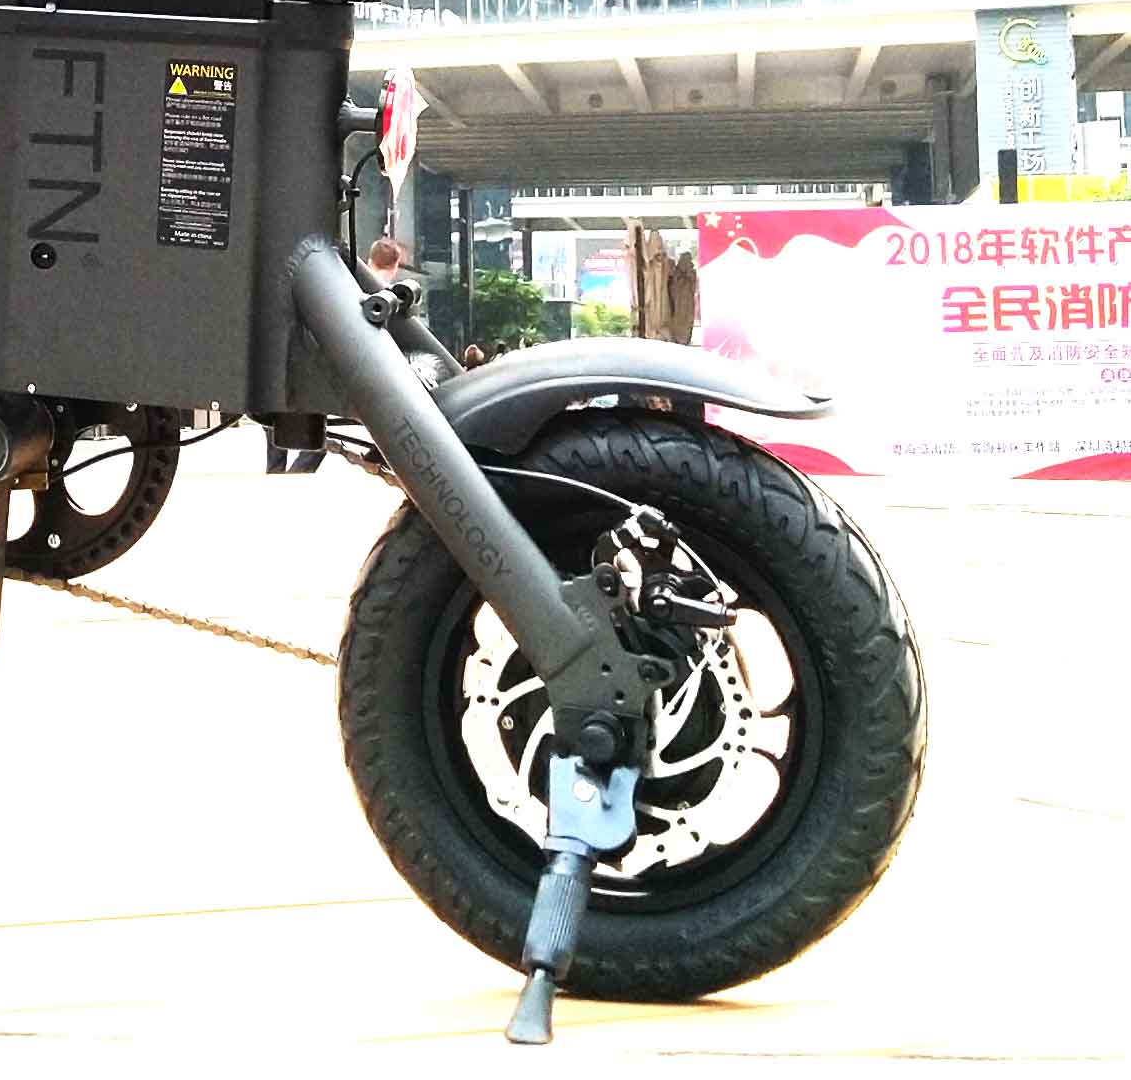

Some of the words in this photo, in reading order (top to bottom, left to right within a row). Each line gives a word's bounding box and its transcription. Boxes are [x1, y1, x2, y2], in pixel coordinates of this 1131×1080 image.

[170, 63, 234, 80] WARNING
[27, 48, 105, 243] FTN
[885, 225, 1131, 266] 2018年软件产
[942, 282, 1131, 333] 全民消防
[395, 416, 512, 577] TECHNOLOGY
